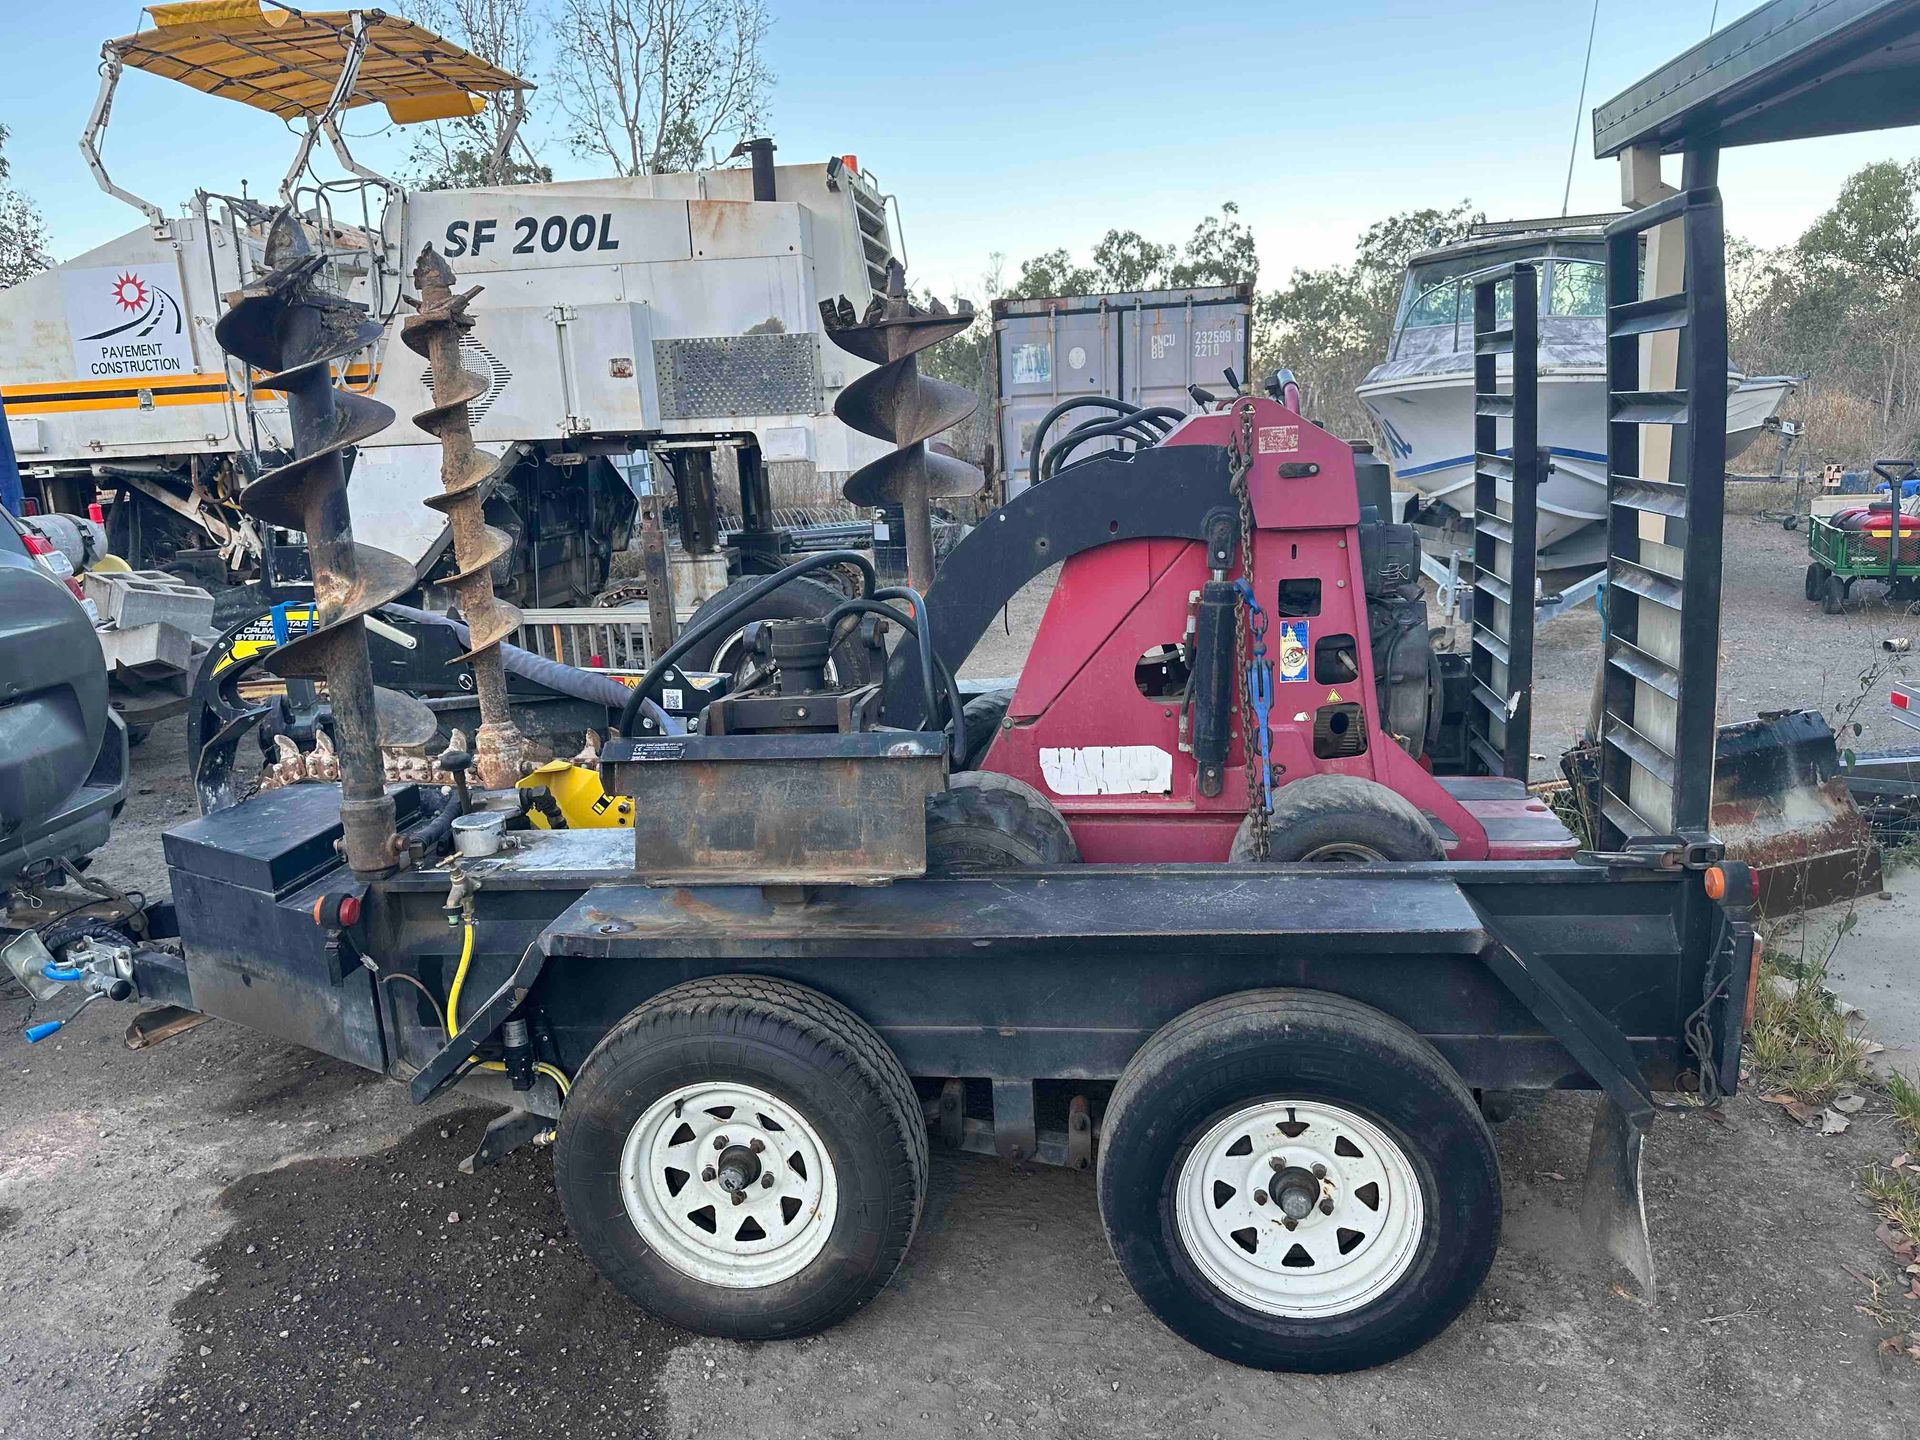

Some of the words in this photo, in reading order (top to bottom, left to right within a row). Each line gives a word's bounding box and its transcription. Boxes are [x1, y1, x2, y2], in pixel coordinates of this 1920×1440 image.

[444, 219, 497, 258] SF
[512, 213, 620, 254] 200L
[1195, 331, 1231, 344] 232599
[101, 343, 162, 358] PAVEMENT
[1194, 343, 1220, 357] 2210
[91, 358, 180, 375] CONSTRUCTION
